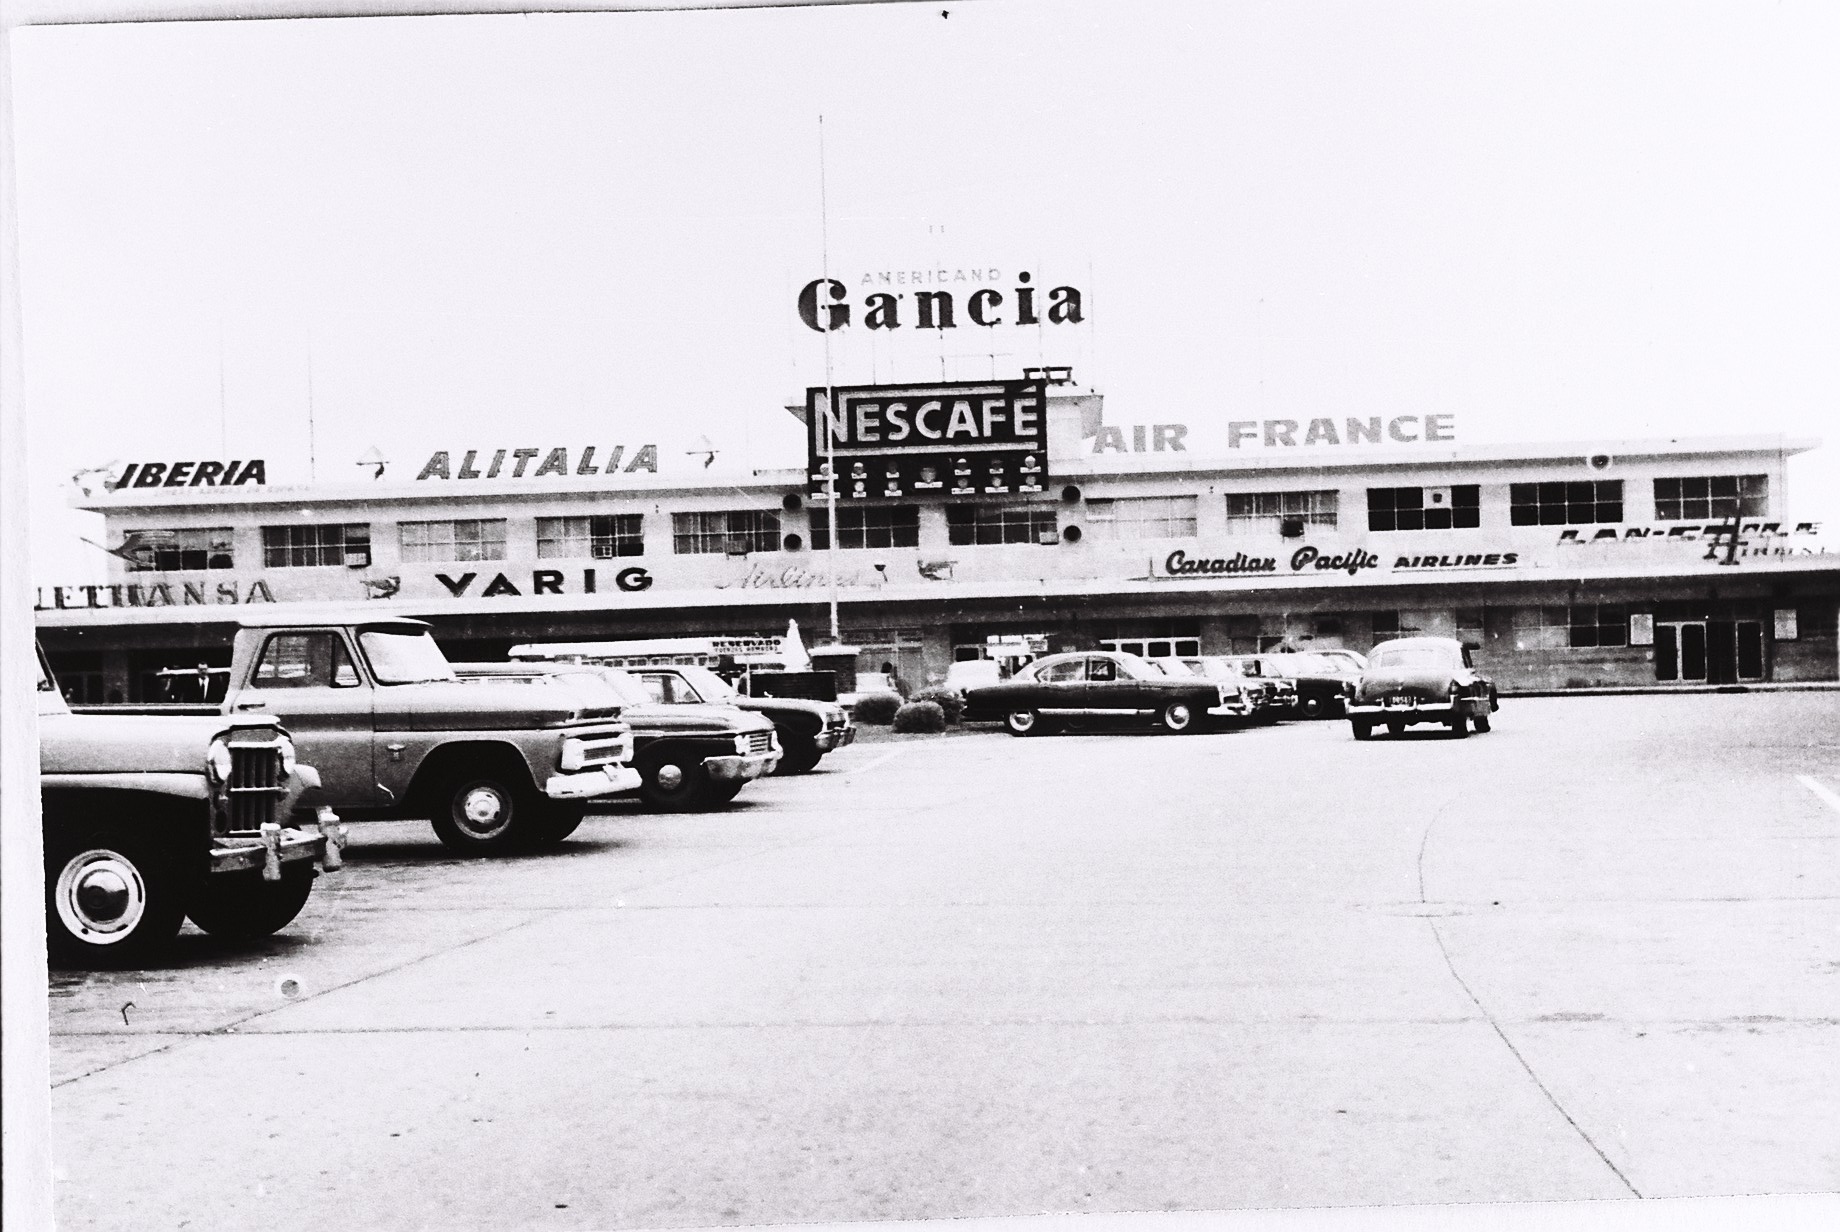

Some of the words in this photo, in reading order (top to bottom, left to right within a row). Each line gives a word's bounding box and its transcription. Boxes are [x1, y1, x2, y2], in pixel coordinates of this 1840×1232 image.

[797, 271, 1085, 333] Gancia
[1092, 424, 1188, 453] AIR
[1228, 414, 1455, 449] FRANCE
[115, 459, 266, 489] IBERIA
[416, 444, 658, 480] ALITALIA
[1165, 550, 1276, 575] Canadian
[1290, 545, 1378, 575] Pacific
[1394, 552, 1518, 568] AIRLINES
[434, 567, 653, 597] VARIG
[712, 639, 781, 648] RESERVADO
